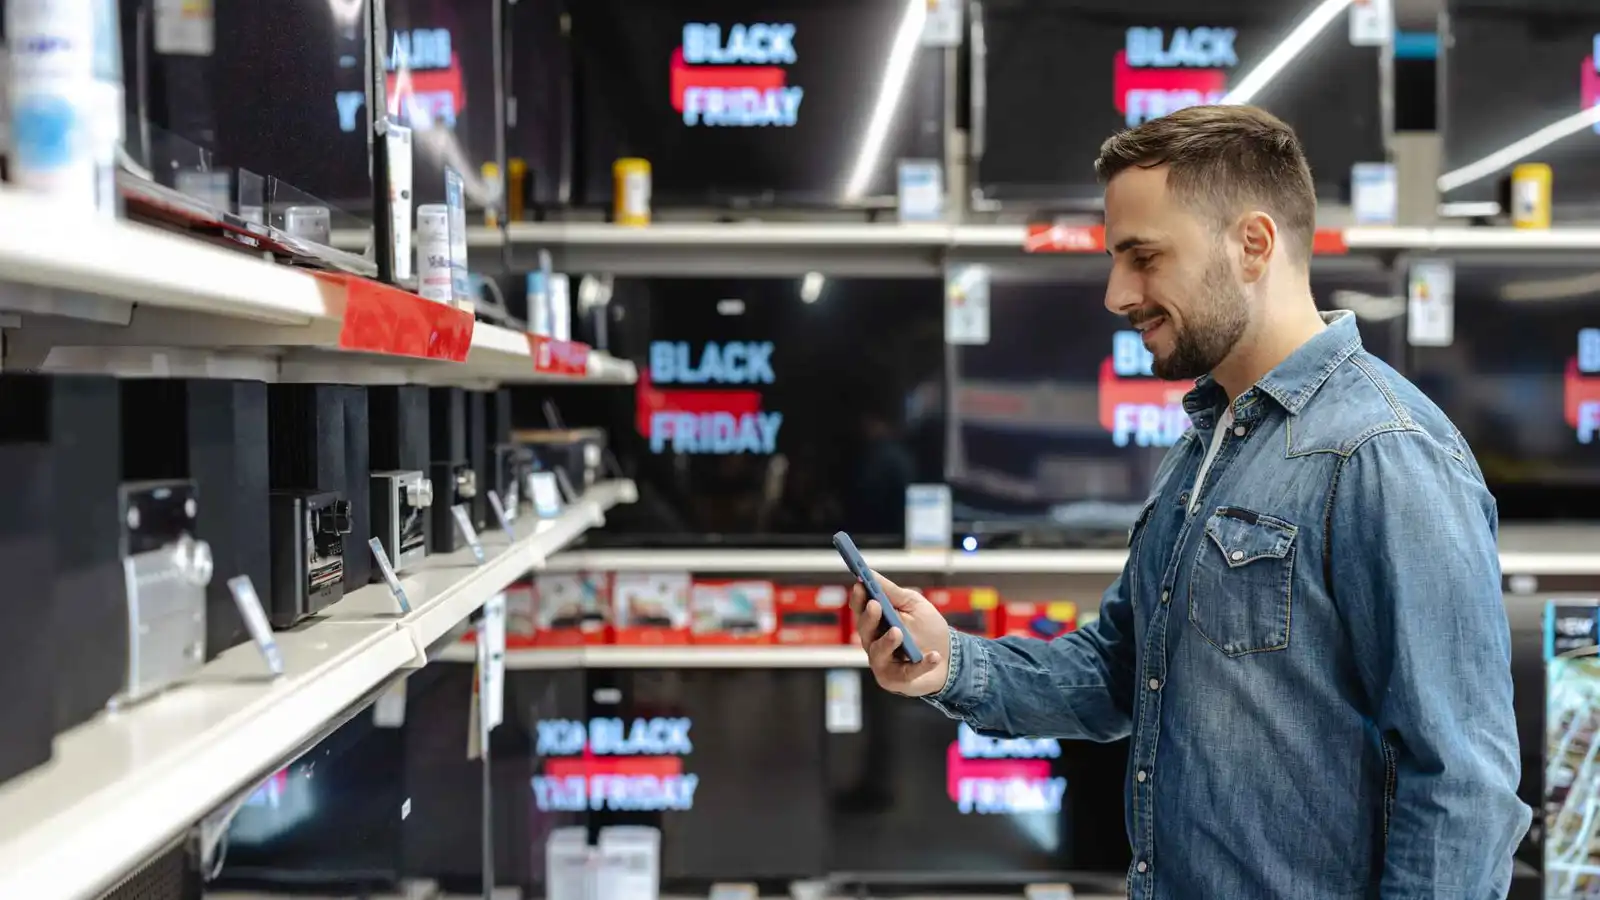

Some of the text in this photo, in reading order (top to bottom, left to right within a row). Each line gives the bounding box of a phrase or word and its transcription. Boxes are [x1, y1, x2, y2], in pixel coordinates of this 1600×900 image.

[683, 22, 797, 64] BLACK
[1125, 26, 1239, 67] BLACK
[683, 86, 803, 126] FRIDAY
[650, 340, 776, 384] BLACK
[650, 411, 783, 454] FRIDAY
[589, 717, 692, 754] BLACK
[589, 773, 699, 811] FRIDAY
[958, 776, 1067, 814] FRIDAY
